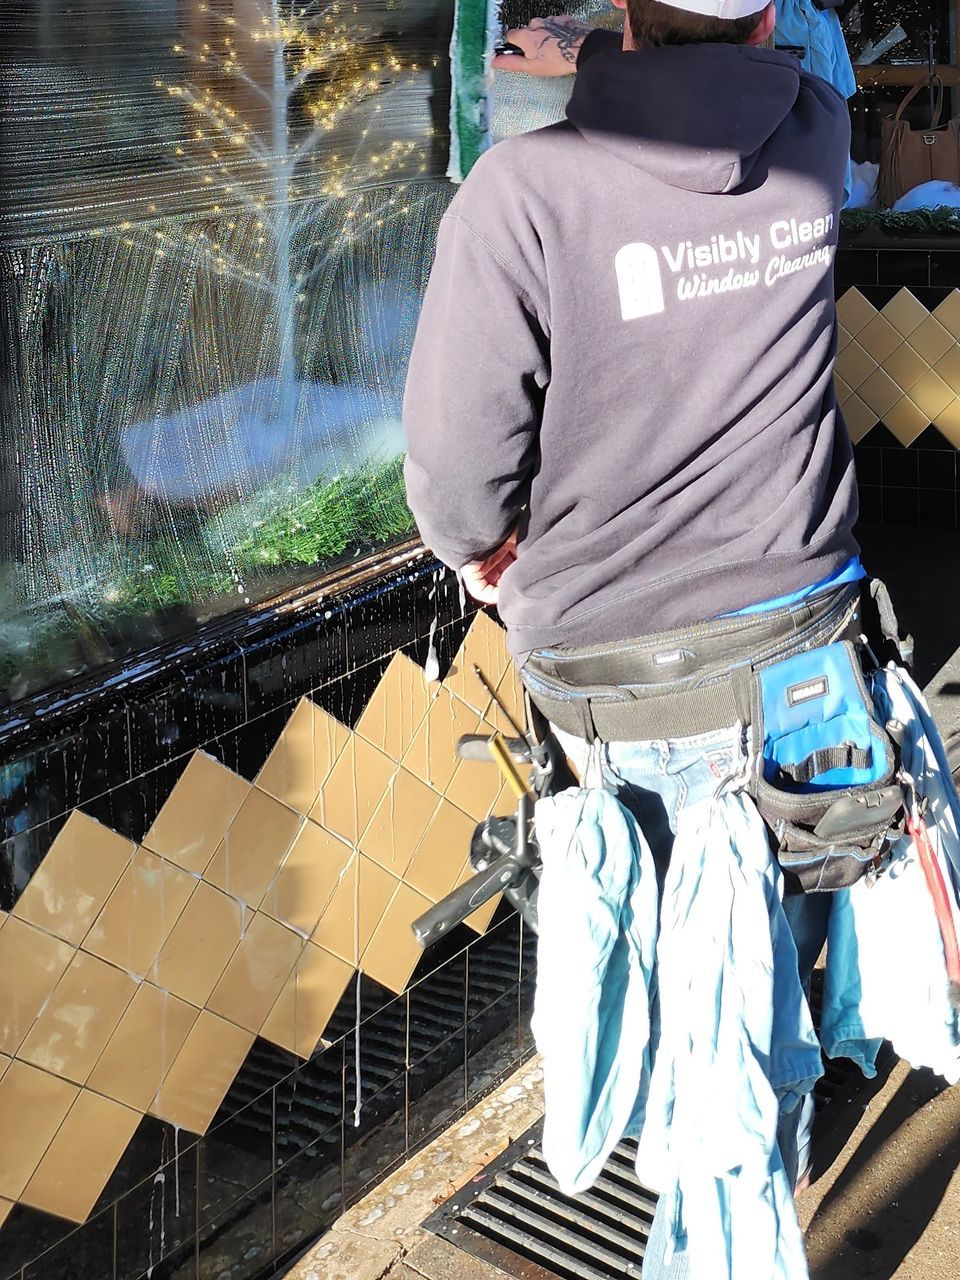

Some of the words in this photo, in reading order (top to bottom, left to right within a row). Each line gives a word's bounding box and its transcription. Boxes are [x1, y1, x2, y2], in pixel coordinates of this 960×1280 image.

[661, 231, 760, 272] Visibly
[769, 213, 834, 249] Clean
[677, 268, 760, 301] Window
[764, 244, 837, 287] Cleaning
